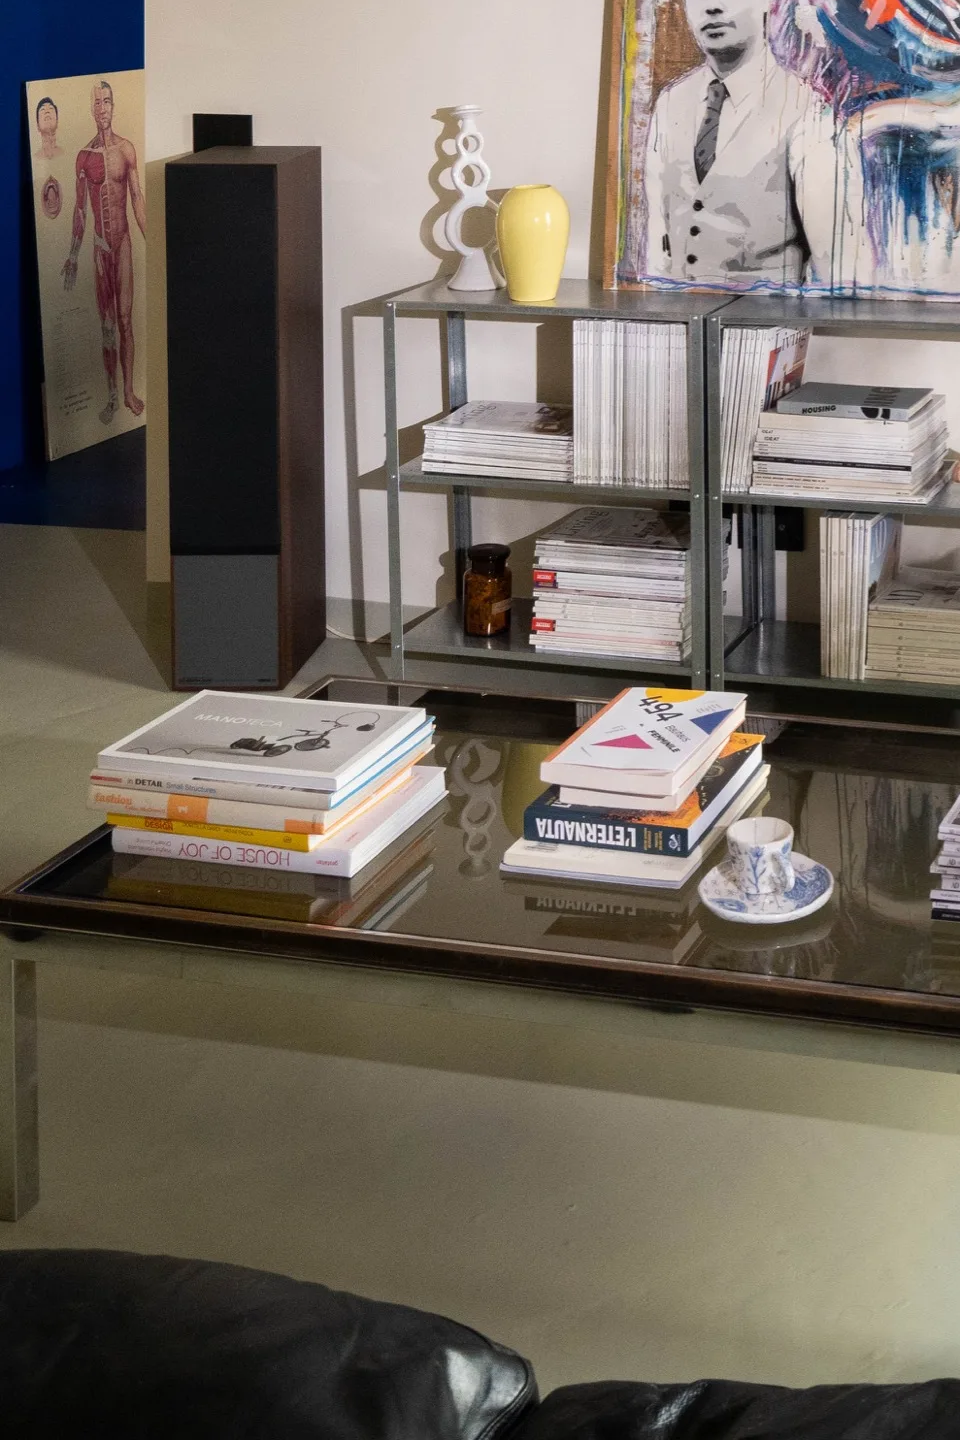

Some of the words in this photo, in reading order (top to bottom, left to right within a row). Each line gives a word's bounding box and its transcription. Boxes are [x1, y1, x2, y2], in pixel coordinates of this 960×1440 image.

[801, 404, 837, 414] HOUSING
[638, 695, 684, 723] 494
[194, 713, 283, 728] MANOTECA
[134, 778, 163, 788] DETAIL
[166, 781, 184, 790] Small
[185, 783, 217, 794] Structures
[94, 792, 132, 806] fashion
[144, 819, 174, 831] DESIGN
[535, 817, 637, 848] L'ETERNAUTA
[178, 842, 209, 859] JOY
[211, 845, 232, 861] OF
[235, 846, 291, 867] HOUSE
